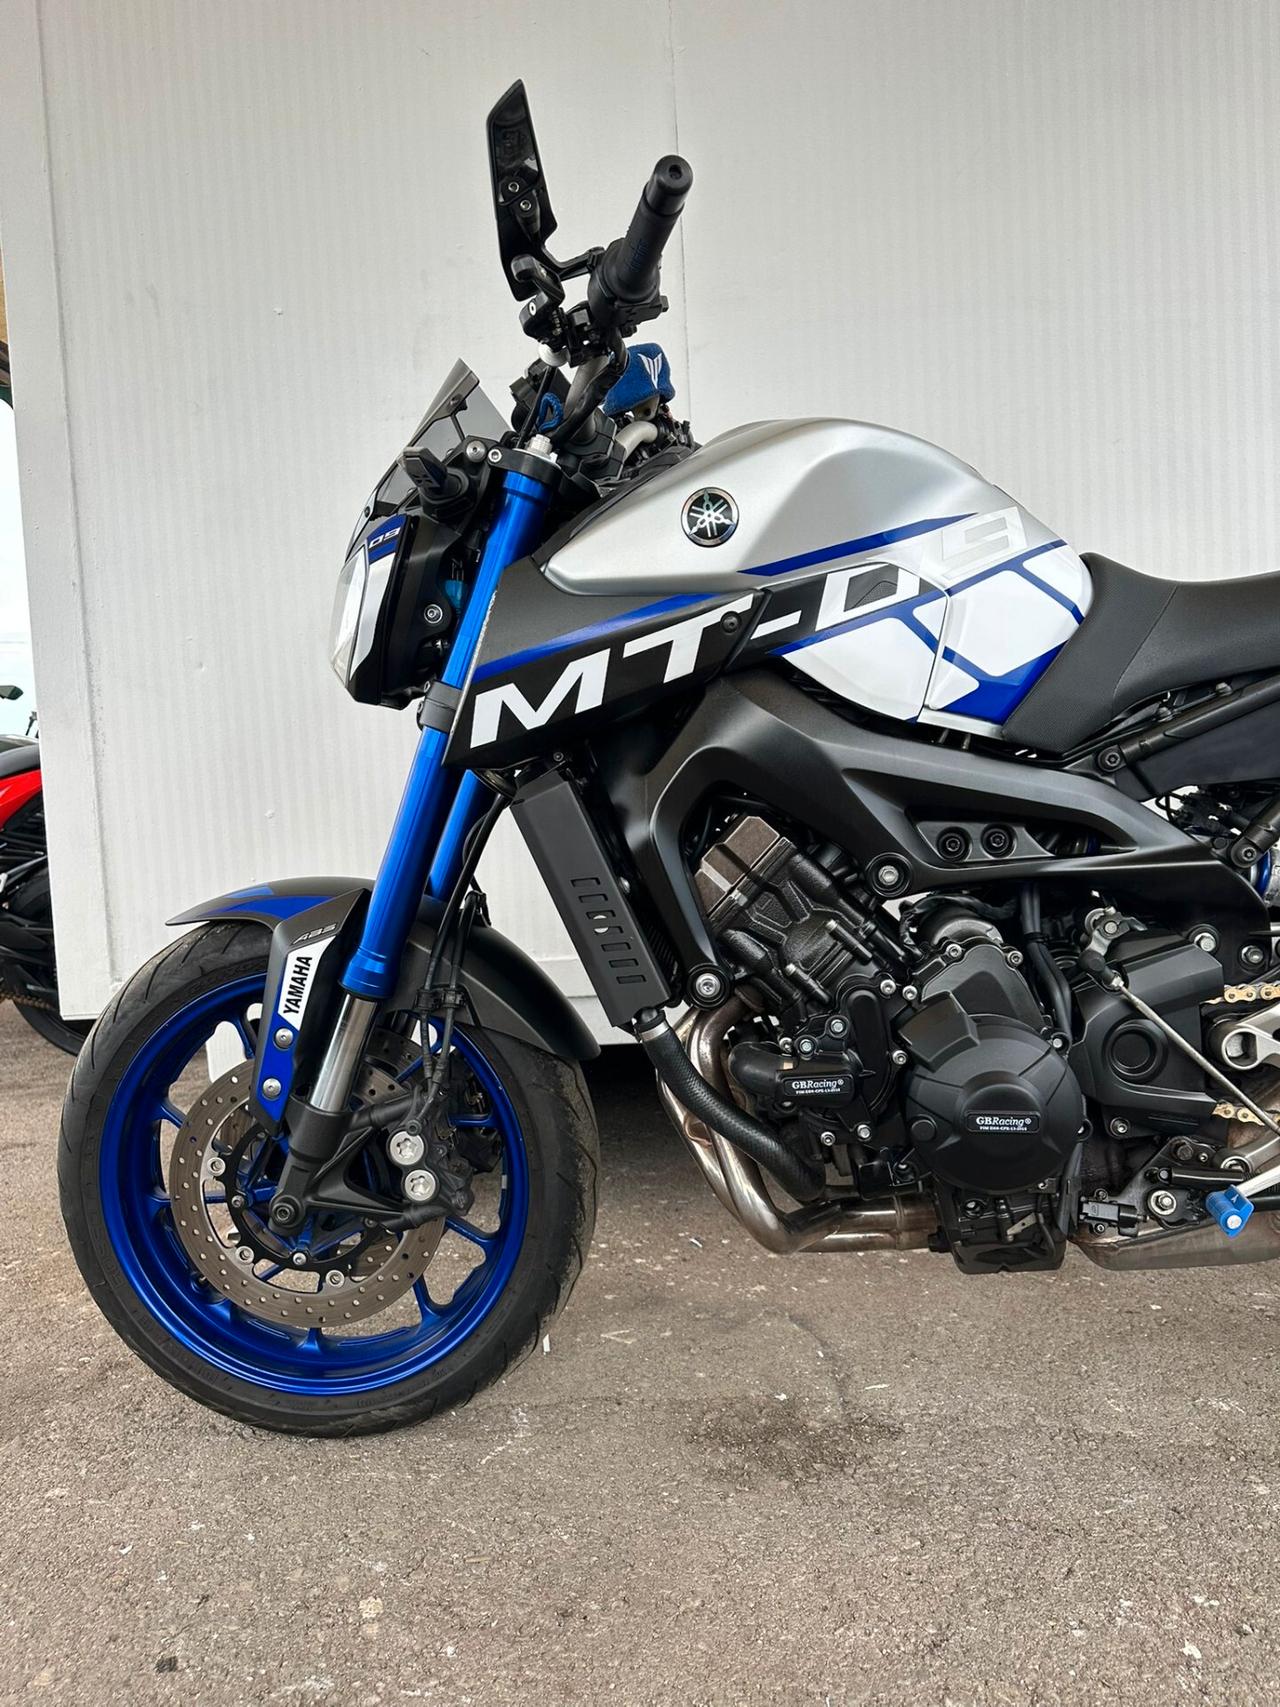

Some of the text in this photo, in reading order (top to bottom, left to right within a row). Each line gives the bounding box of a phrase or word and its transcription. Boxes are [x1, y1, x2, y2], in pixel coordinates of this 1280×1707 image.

[368, 527, 402, 549] 09
[292, 923, 337, 944] ABS
[283, 956, 313, 1014] YAMAHA
